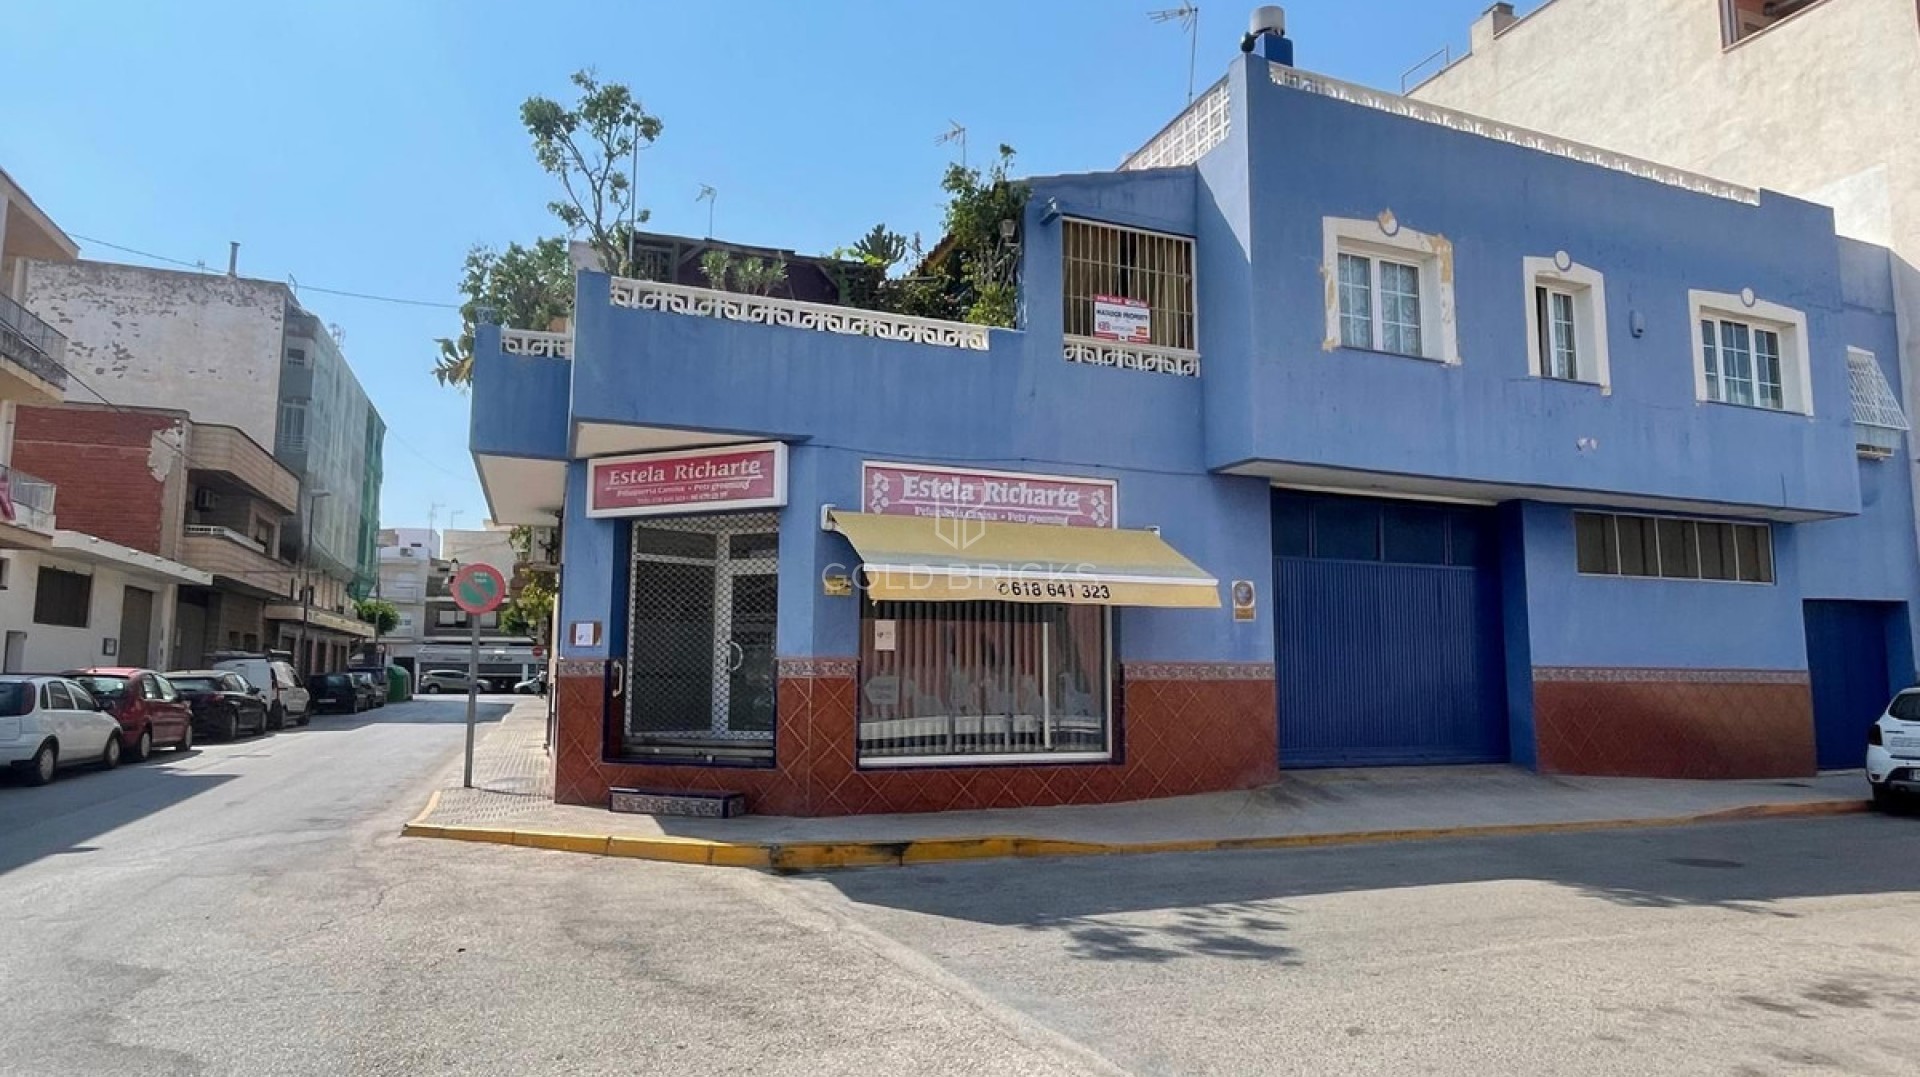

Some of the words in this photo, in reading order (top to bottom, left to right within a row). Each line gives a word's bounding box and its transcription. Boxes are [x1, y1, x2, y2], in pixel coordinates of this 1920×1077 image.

[609, 466, 665, 486] Estela
[675, 460, 761, 480] Richarte
[903, 475, 973, 500] Estela
[983, 479, 1080, 507] Richarte
[1012, 581, 1041, 597] 618
[1047, 582, 1075, 598] 641
[1081, 584, 1111, 599] 323
